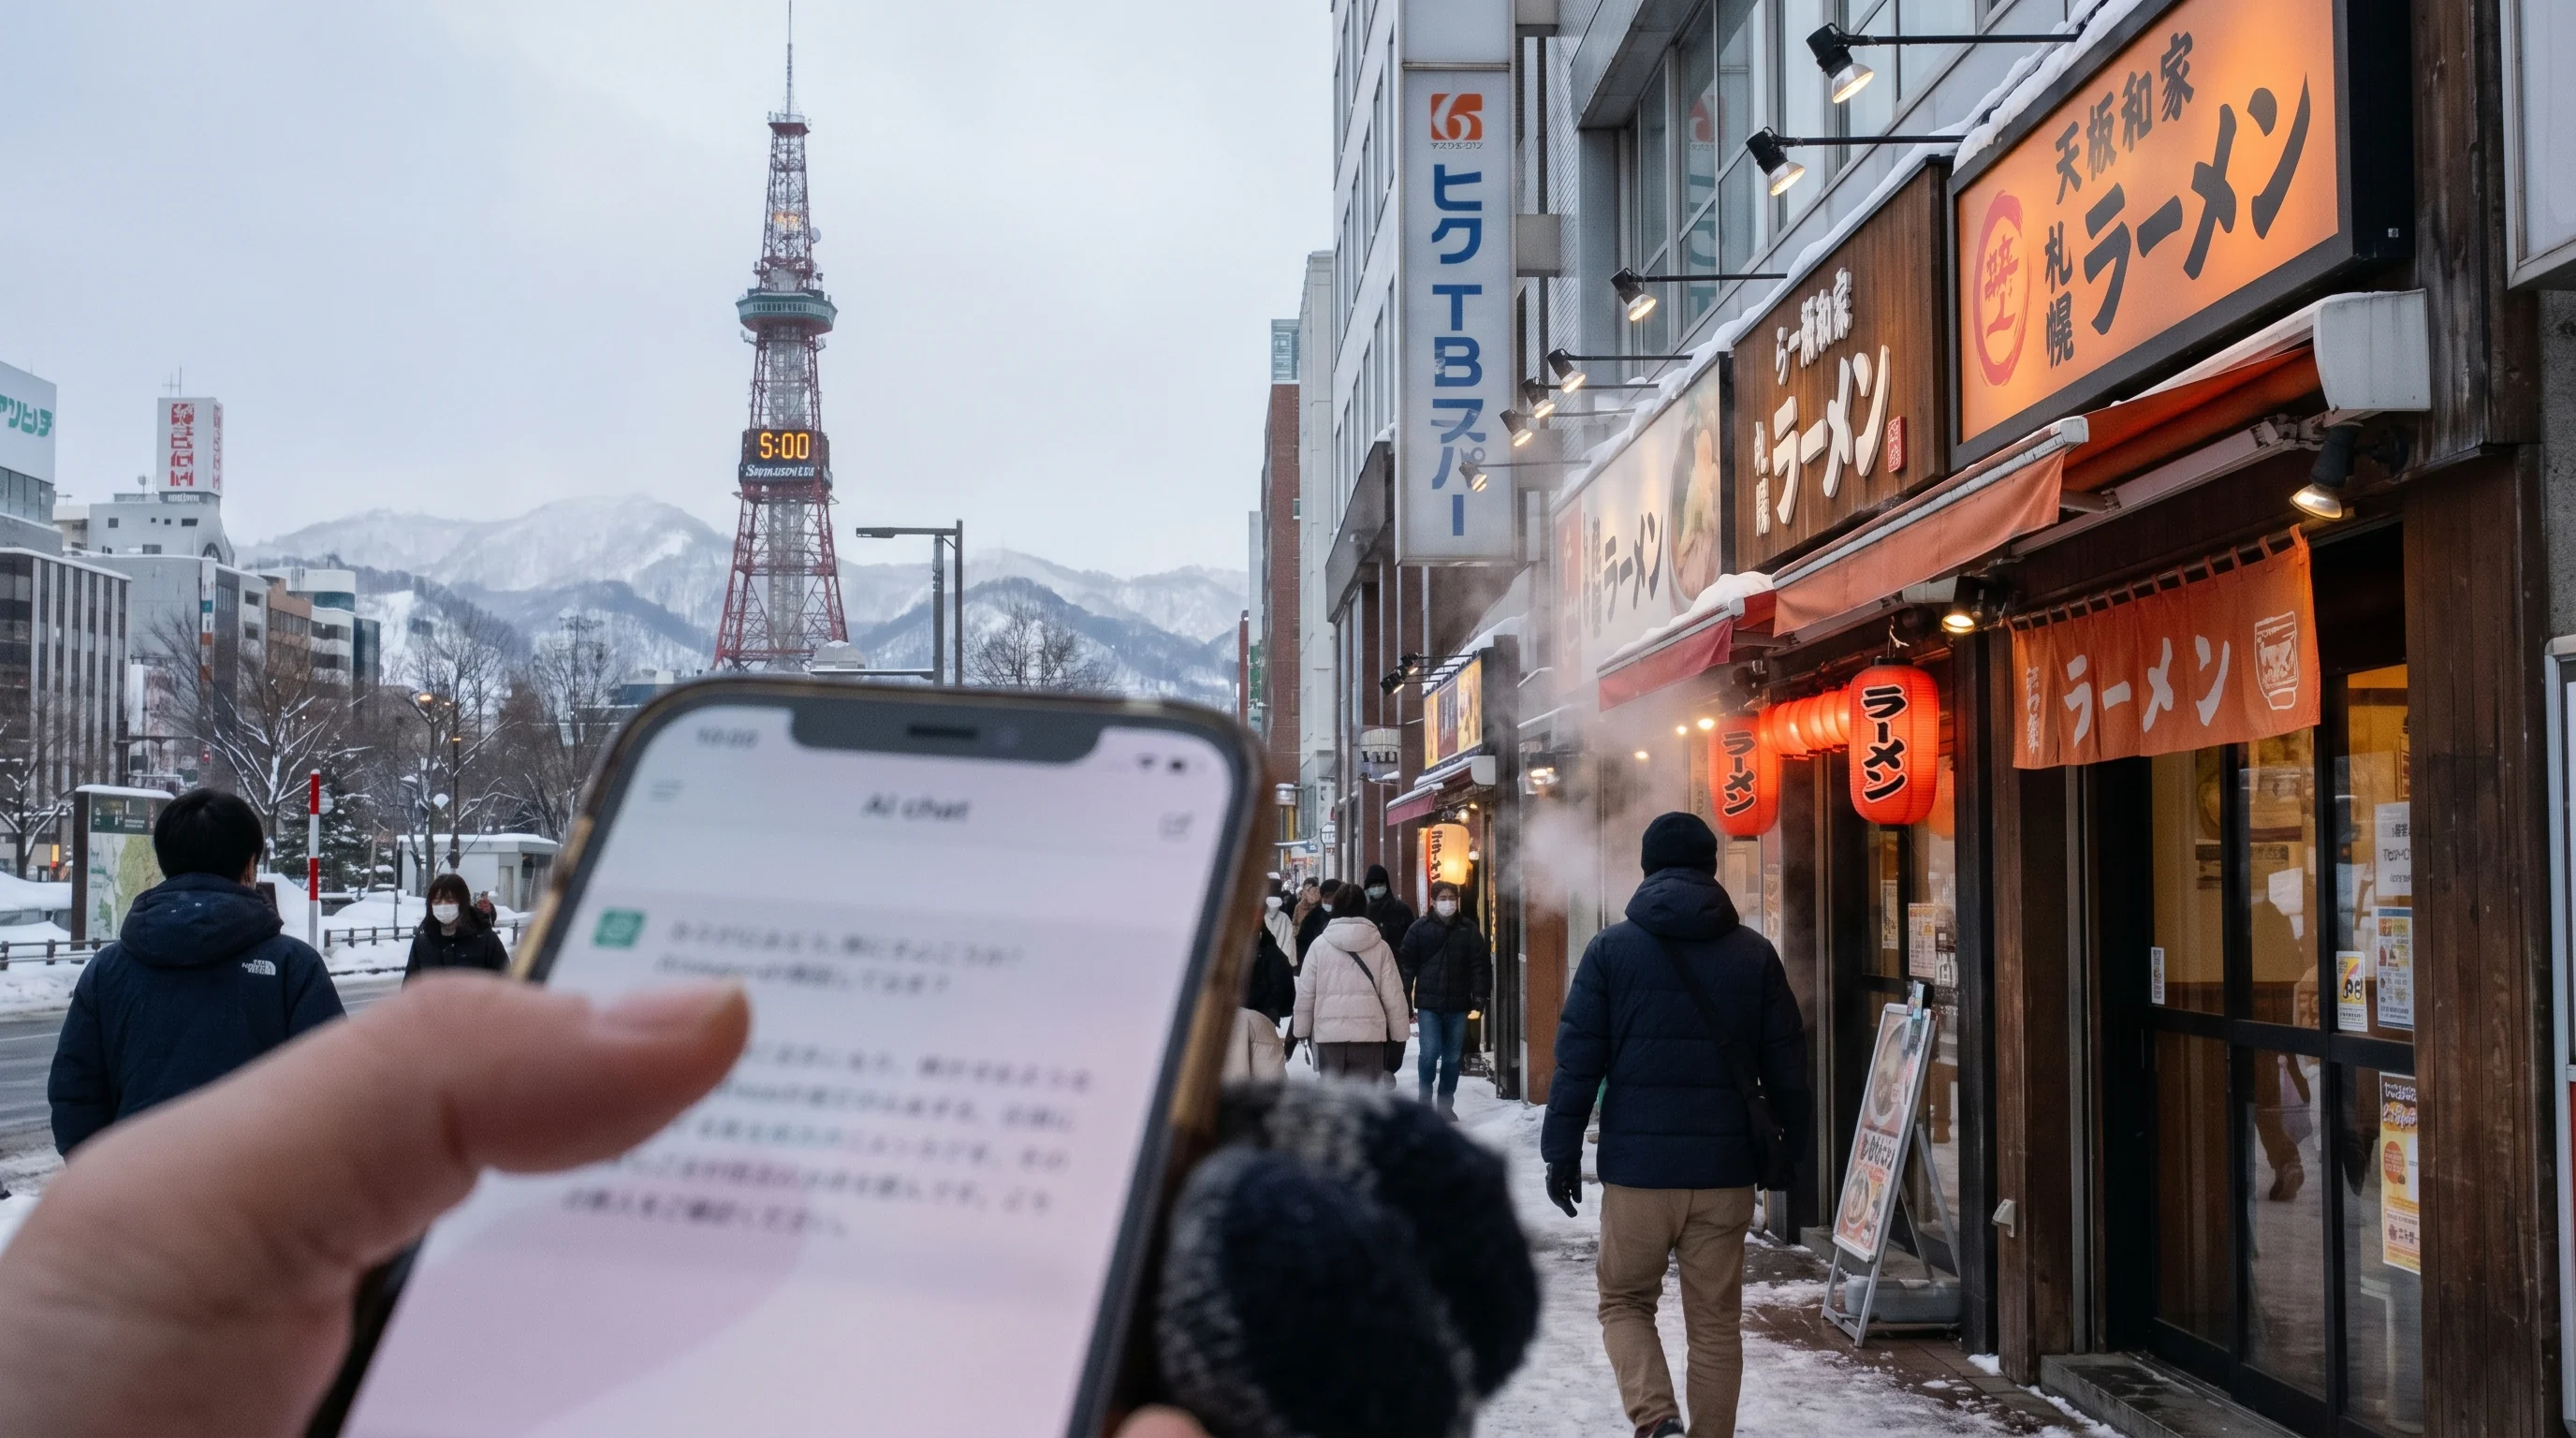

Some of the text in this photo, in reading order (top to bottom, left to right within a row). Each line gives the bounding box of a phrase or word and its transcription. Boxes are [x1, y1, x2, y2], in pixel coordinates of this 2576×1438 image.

[2083, 71, 2311, 336] ラーメン
[2044, 221, 2075, 370] 札幌
[759, 432, 810, 460] 5:00
[1773, 345, 1891, 525] ラーメン
[1603, 511, 1664, 624] ラーメン
[1862, 685, 1908, 802] ラーメン
[2063, 635, 2231, 749] ラーメン
[900, 793, 970, 822] chat
[1721, 730, 1757, 817] ラーメン
